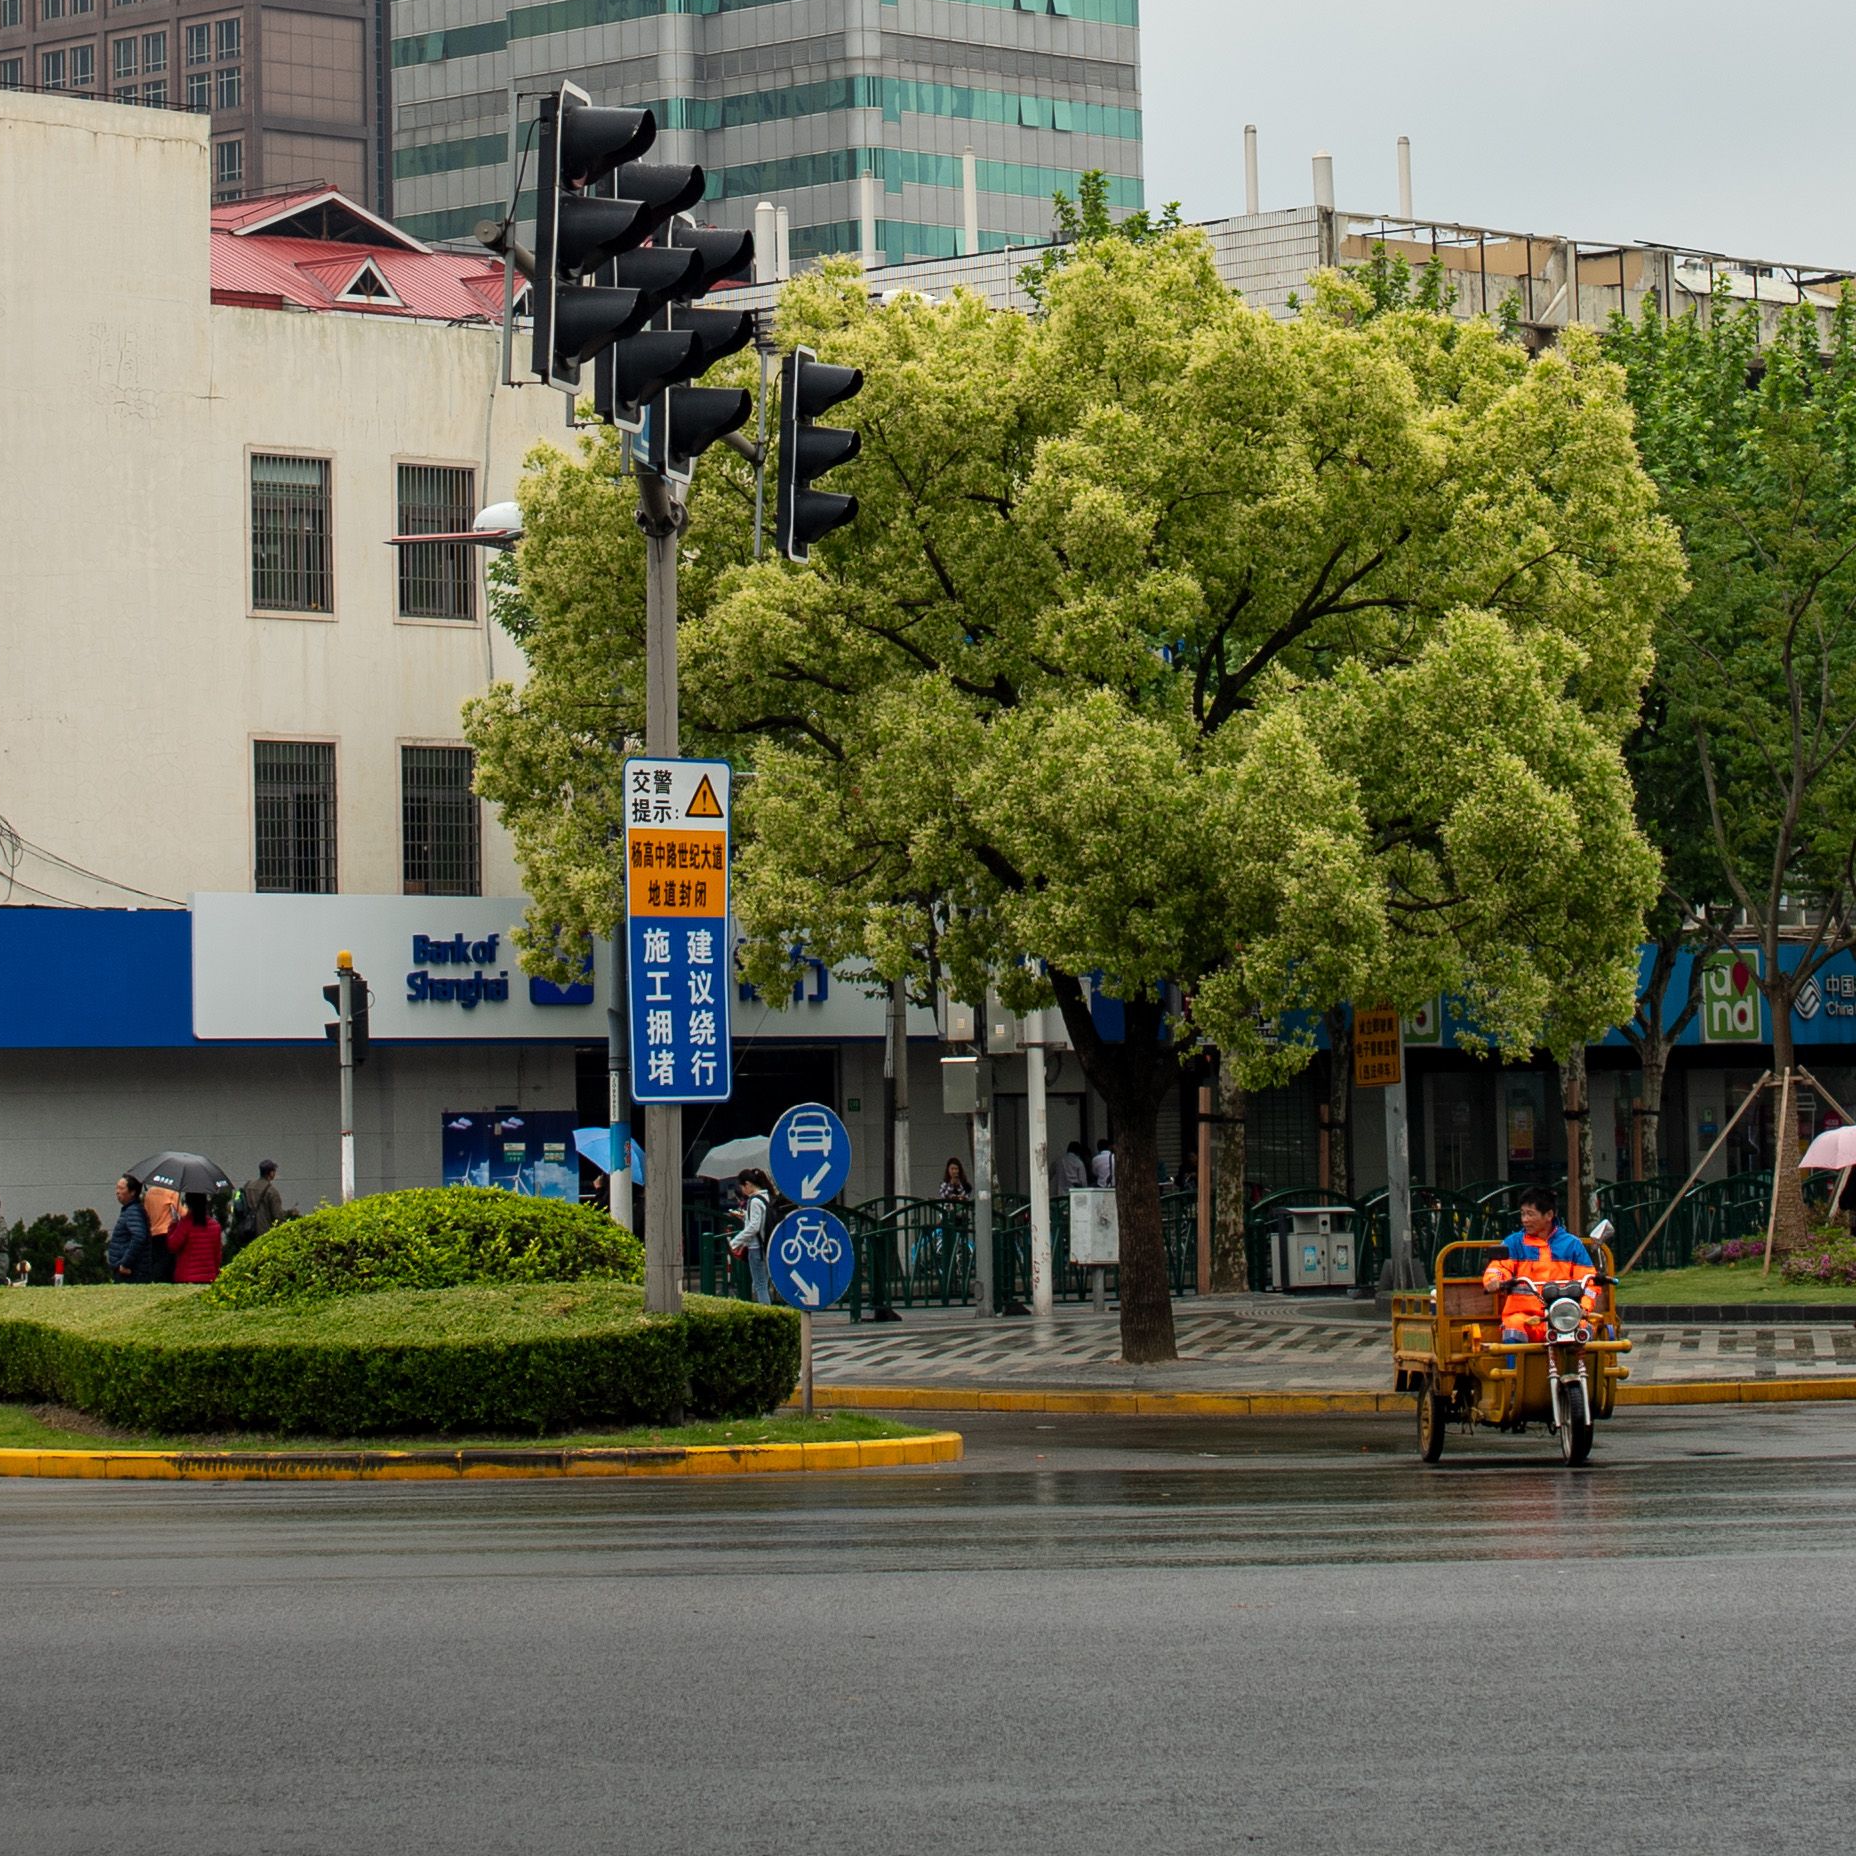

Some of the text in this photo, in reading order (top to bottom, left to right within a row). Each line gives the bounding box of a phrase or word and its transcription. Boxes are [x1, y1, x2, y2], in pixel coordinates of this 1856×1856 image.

[632, 769, 673, 795] 交警
[631, 841, 723, 870] 杨高中路世纪大道
[648, 879, 707, 908] 地道封闭
[412, 933, 500, 964] Bank of
[406, 970, 508, 1009] Shanghai
[643, 928, 675, 1086] 施工拥堵
[687, 928, 717, 1086] 建议绕行
[1827, 1000, 1854, 1016] China
